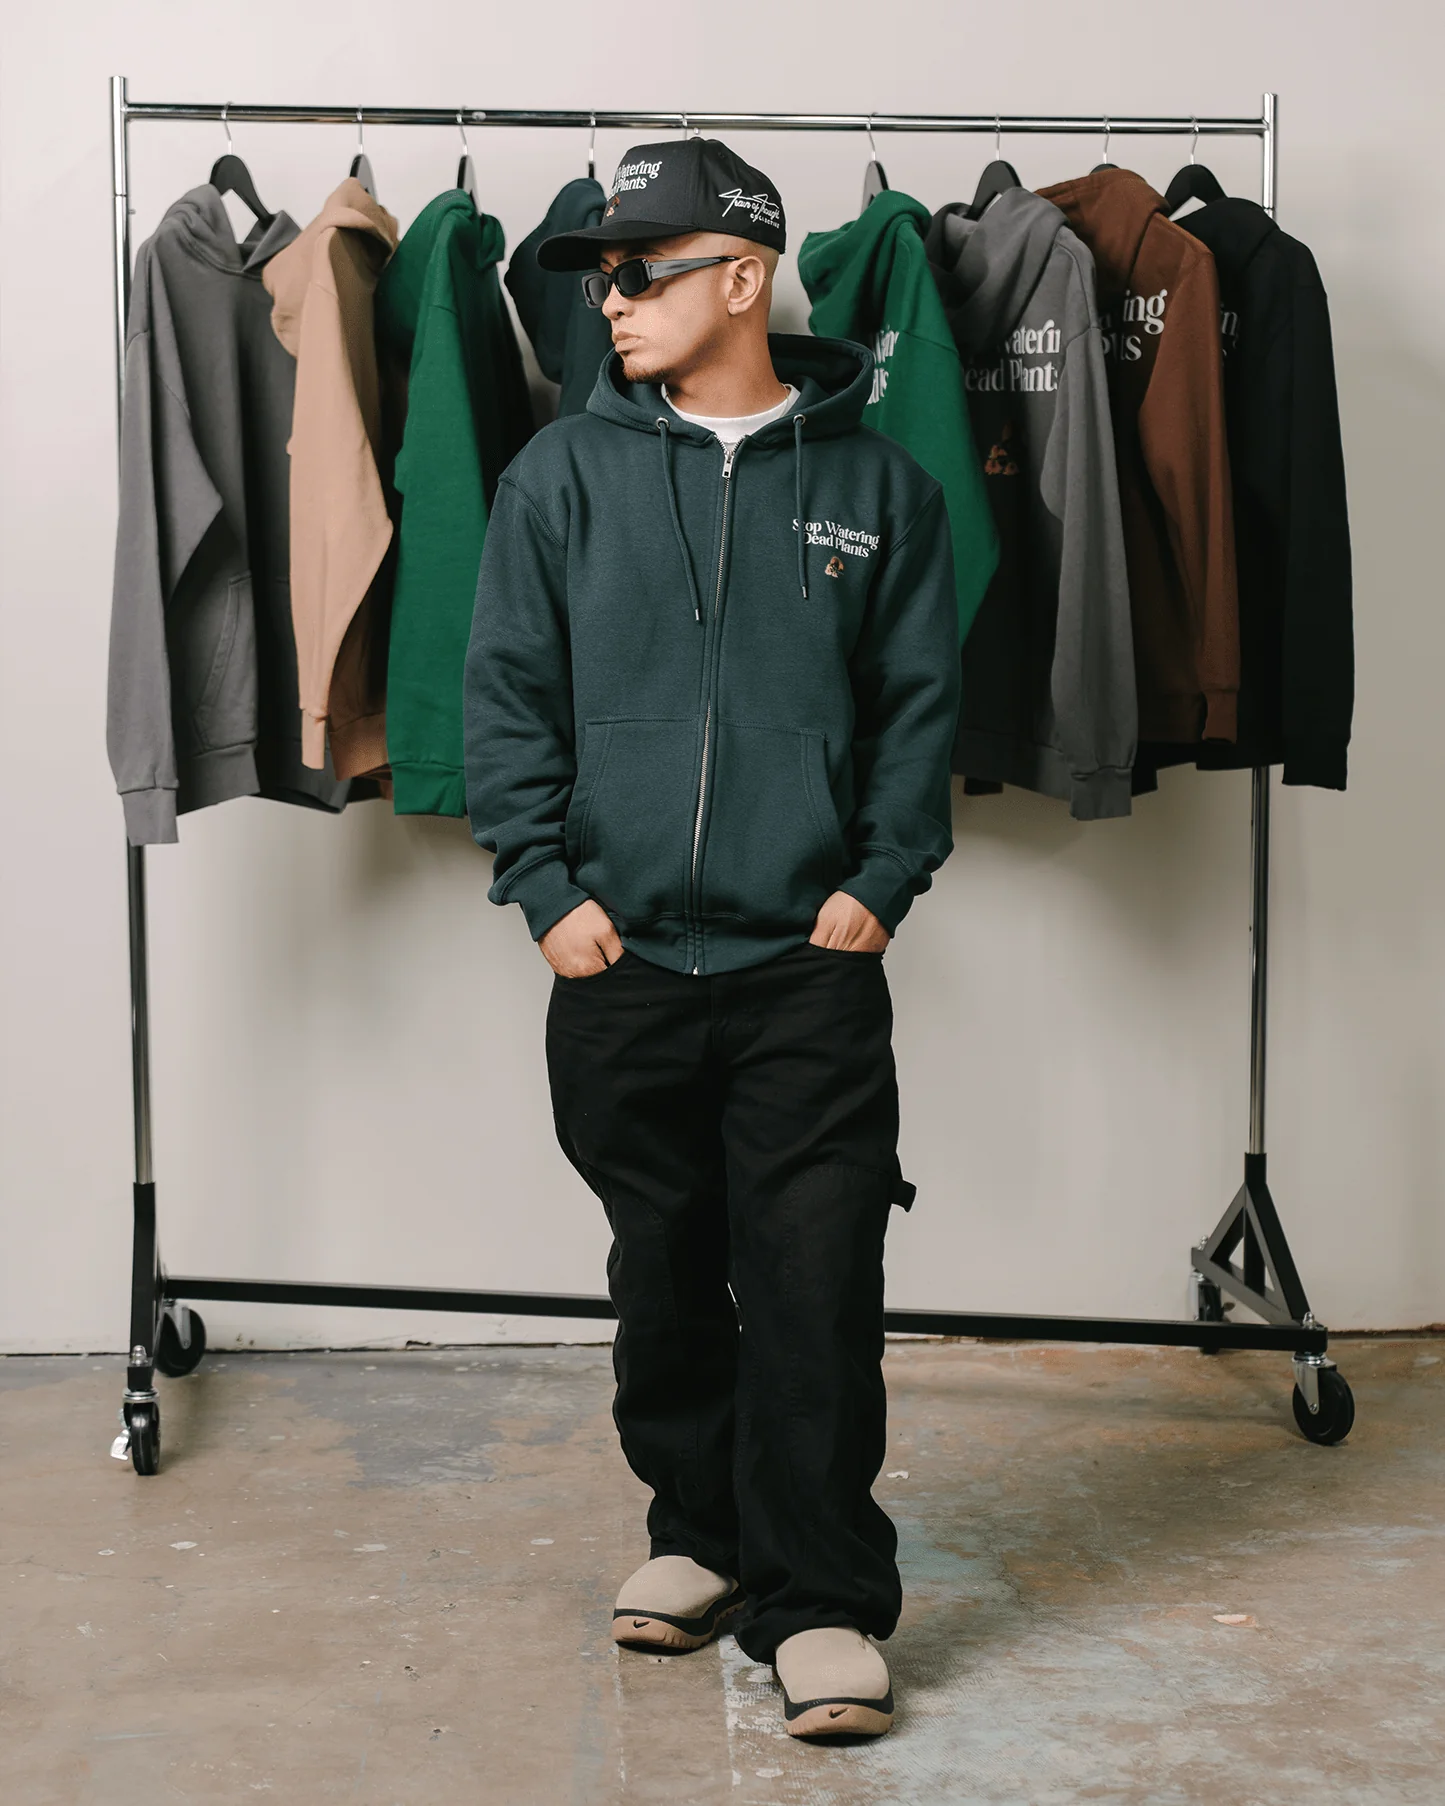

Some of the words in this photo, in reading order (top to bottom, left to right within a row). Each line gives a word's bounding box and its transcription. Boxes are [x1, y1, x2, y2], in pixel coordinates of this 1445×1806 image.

[964, 358, 1004, 392] ead
[792, 518, 822, 535] Sop
[825, 520, 880, 550] Watering
[835, 537, 870, 558] Plants
